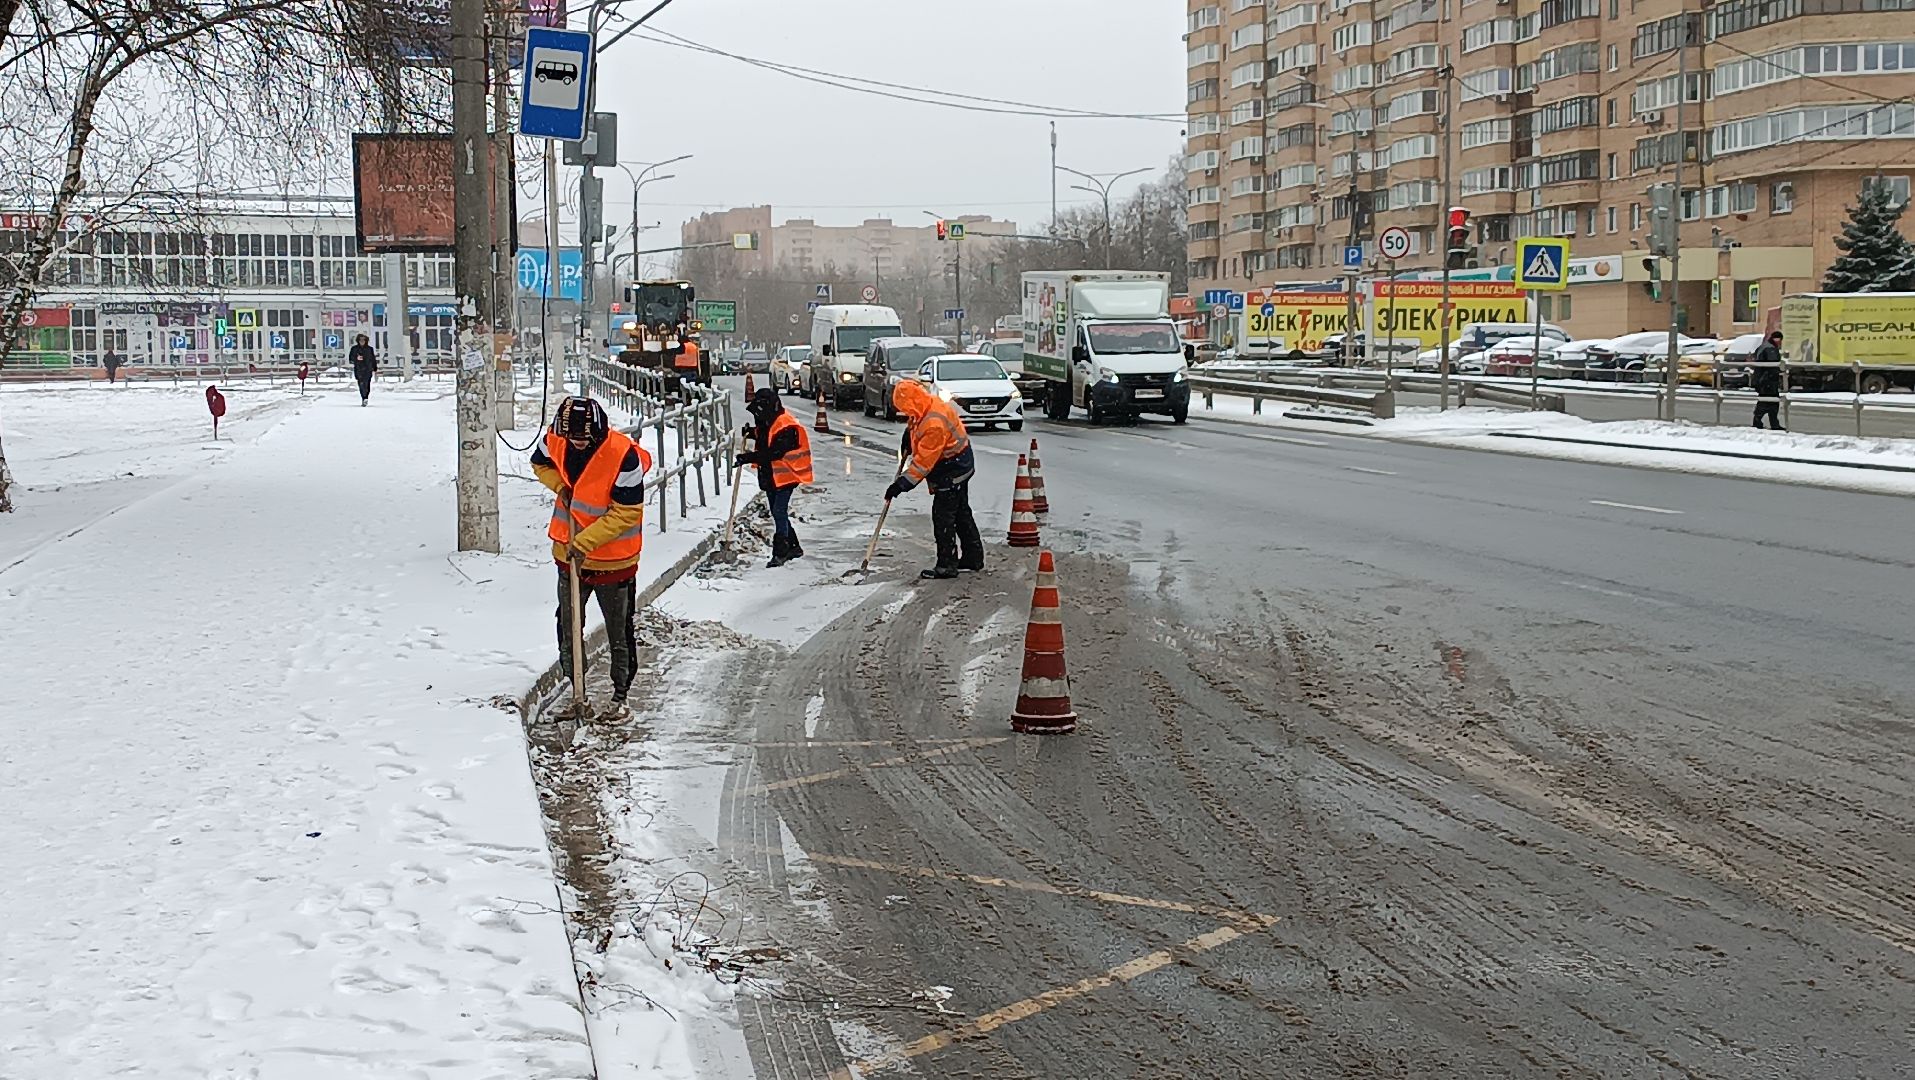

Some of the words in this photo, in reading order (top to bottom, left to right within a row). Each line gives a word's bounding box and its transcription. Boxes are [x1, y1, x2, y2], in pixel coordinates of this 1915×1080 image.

[1385, 236, 1404, 250] 50
[1348, 248, 1359, 263] P
[1233, 296, 1240, 307] P
[1250, 309, 1361, 336] ЭЛЕКТРИКА
[1377, 302, 1516, 331] ЭЛЕКТРИКА
[1825, 322, 1915, 333] КОРЕАН
